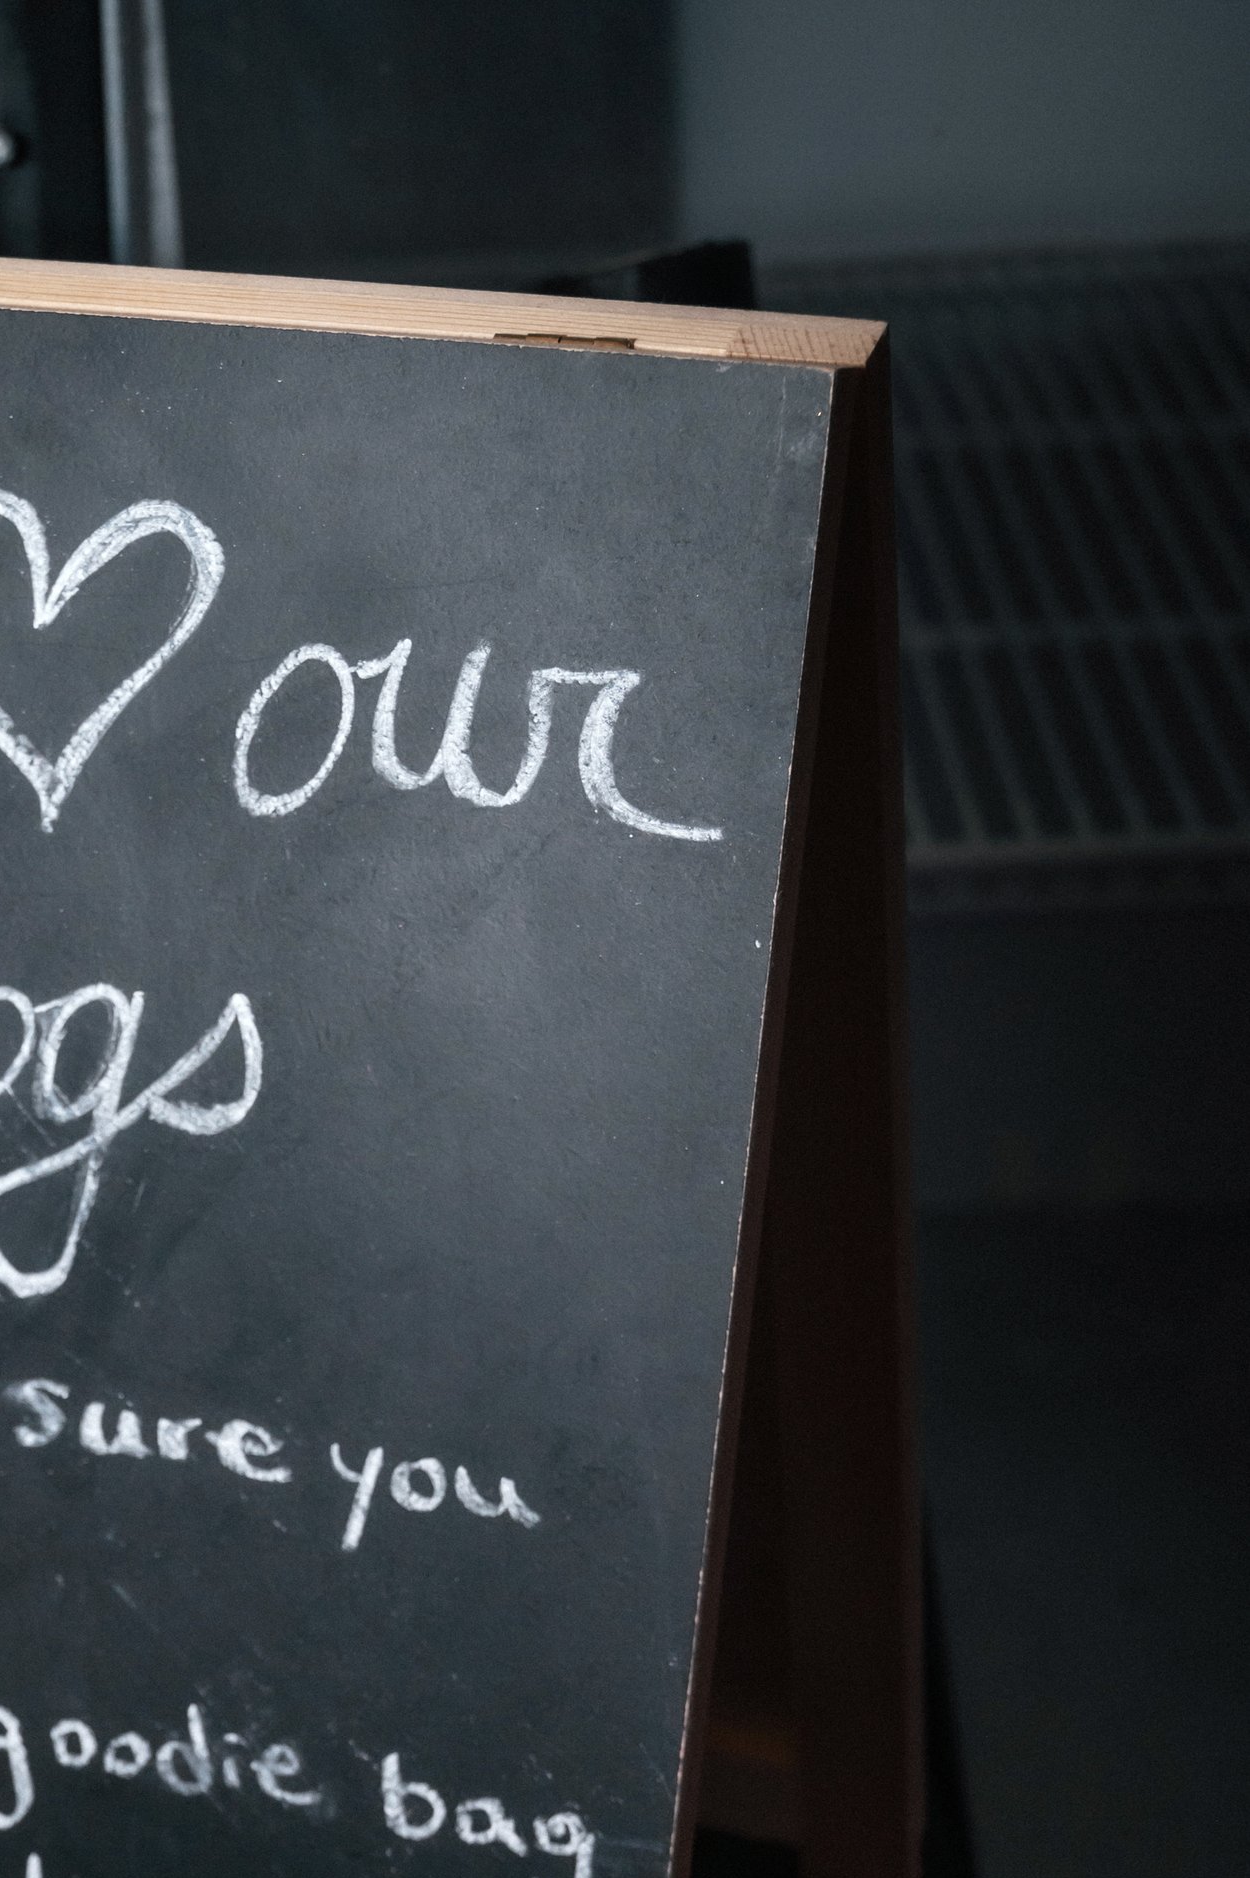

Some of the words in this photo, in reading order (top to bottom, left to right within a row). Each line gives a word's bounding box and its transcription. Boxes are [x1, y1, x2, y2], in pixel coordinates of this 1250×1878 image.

[234, 638, 723, 841] our
[3, 1378, 291, 1484] sure
[330, 1442, 540, 1551] you
